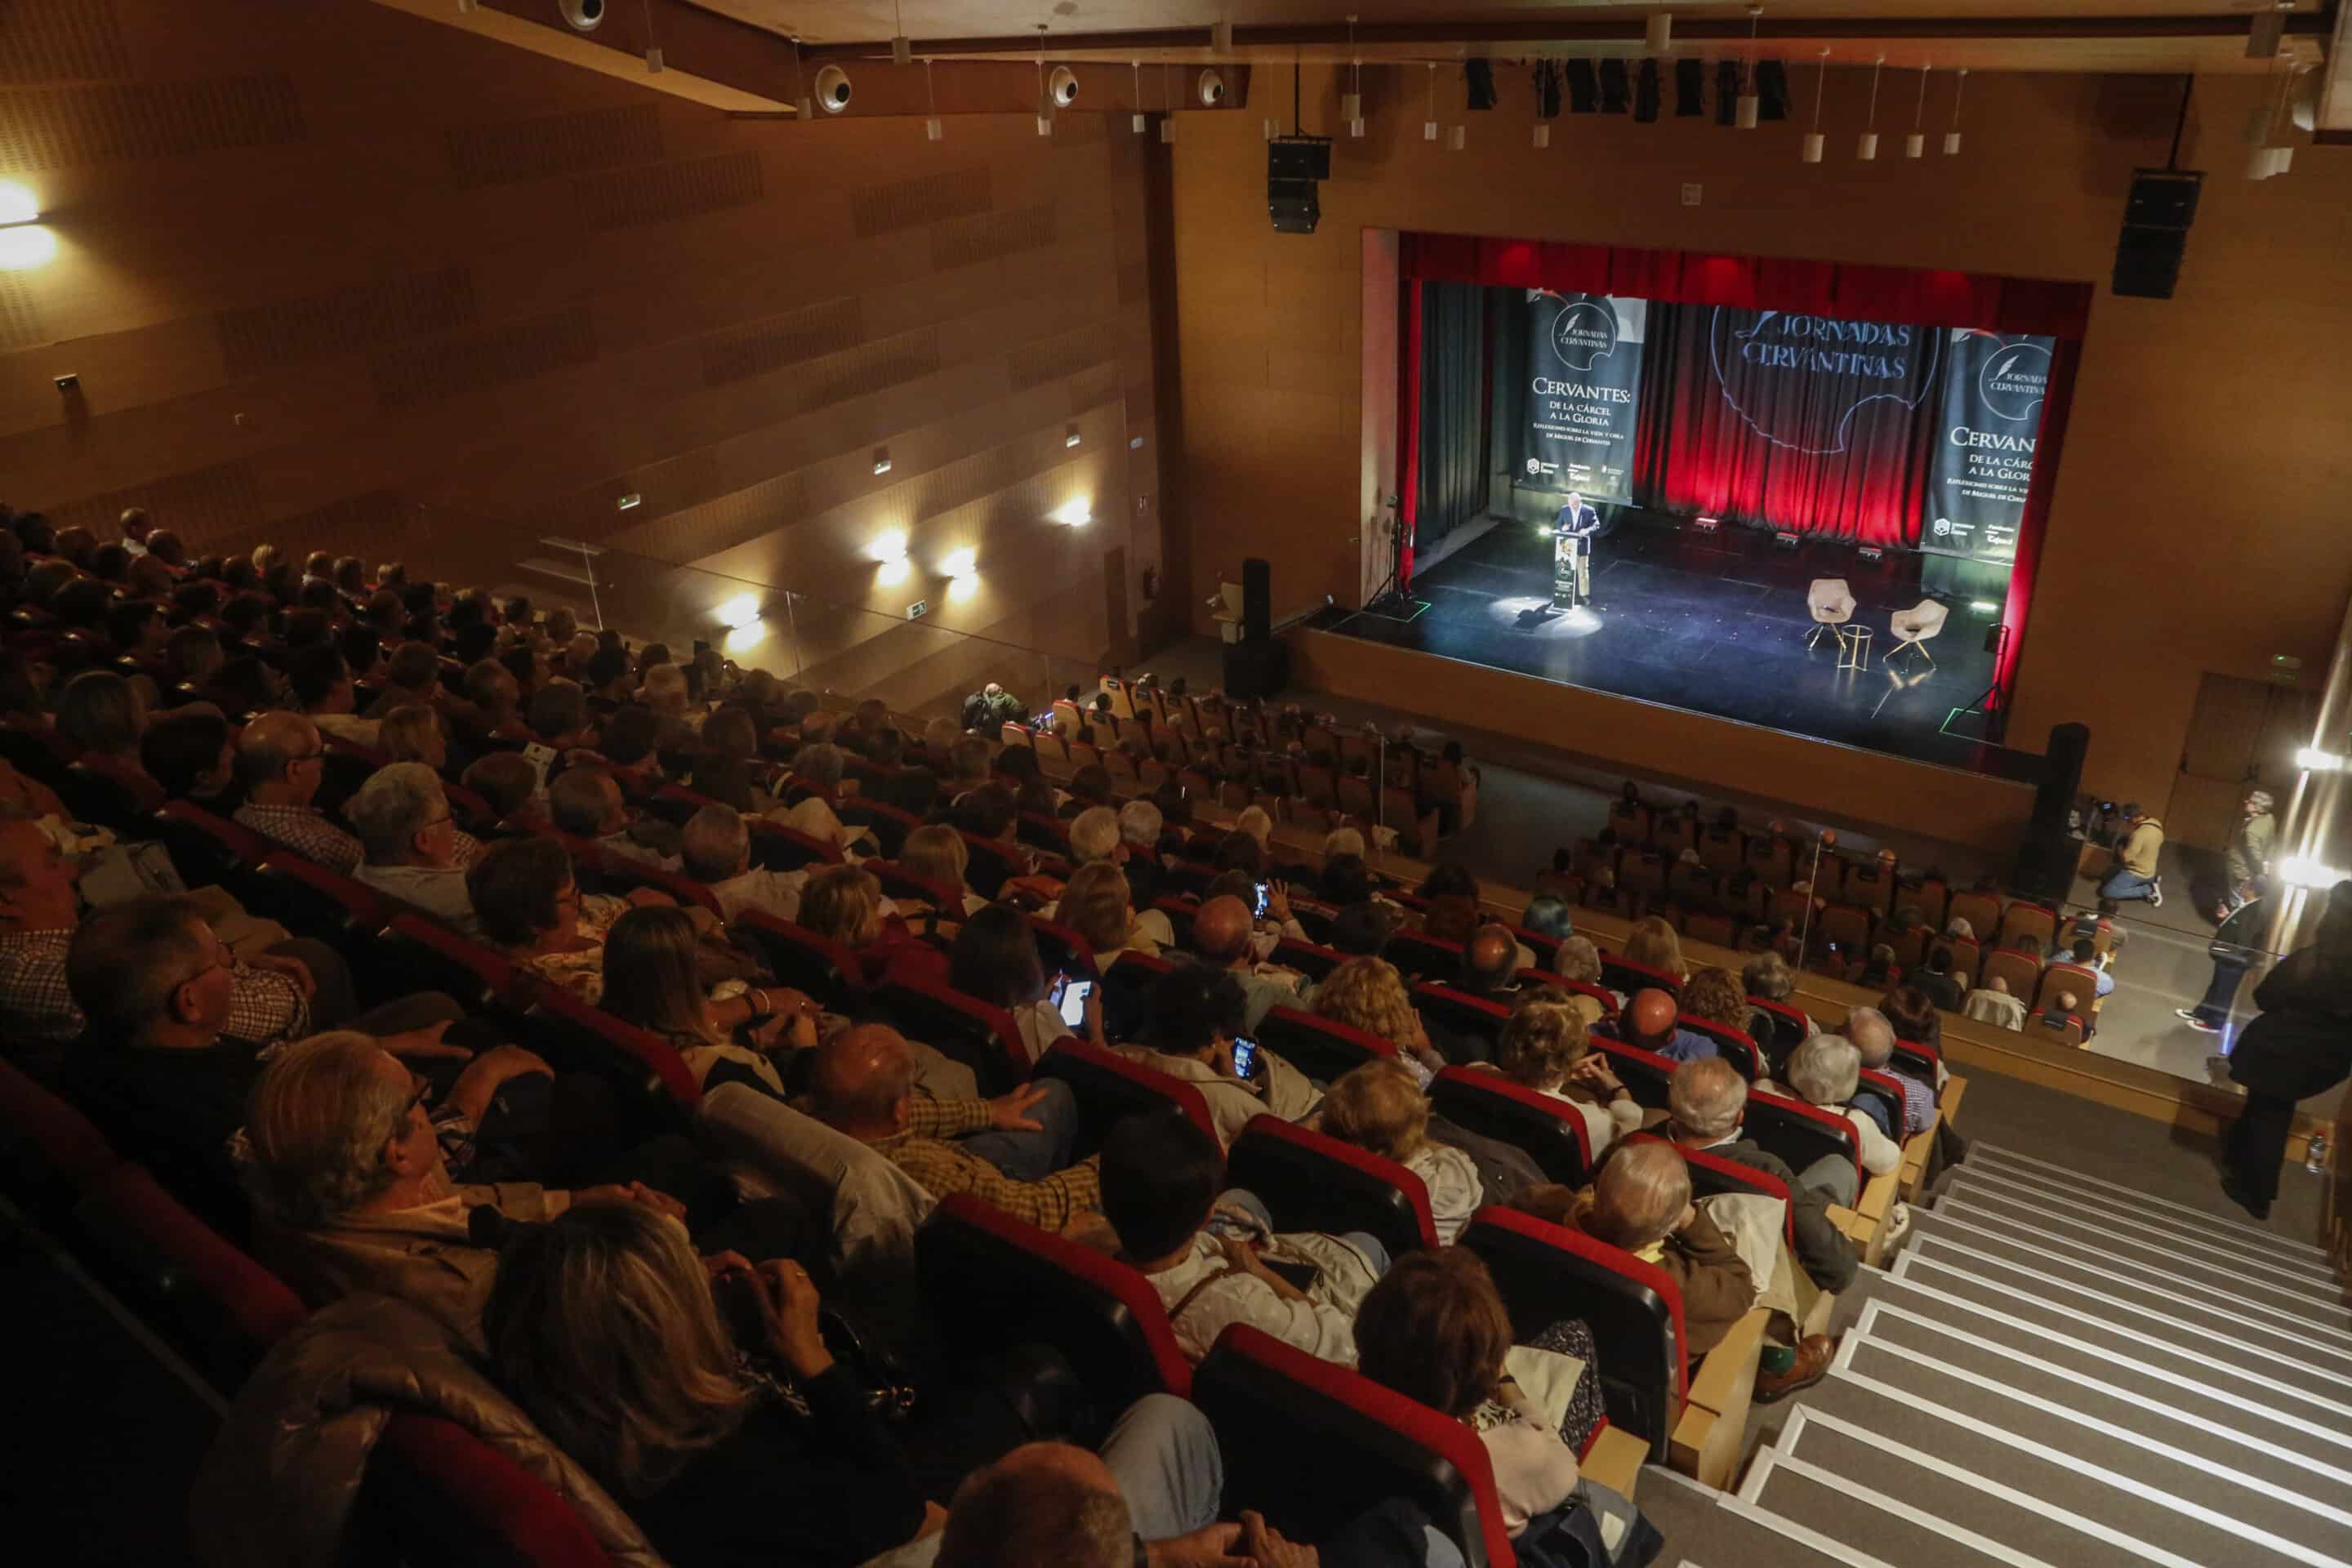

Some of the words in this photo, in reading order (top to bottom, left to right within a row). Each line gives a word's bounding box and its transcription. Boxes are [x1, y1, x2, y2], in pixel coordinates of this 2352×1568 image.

[1779, 314, 1910, 346] JORNADAS
[1532, 376, 1630, 403] CERVANTES:
[1549, 400, 1561, 409] DE
[1563, 402, 1574, 411] LA
[1576, 403, 1611, 416] CÁRCEL
[1559, 412, 1570, 421] LA
[1573, 413, 1610, 426] GLORIA
[1969, 454, 1984, 463] DE
[1986, 456, 2000, 466] LA
[1968, 466, 1976, 474] A
[1980, 467, 1994, 477] LA
